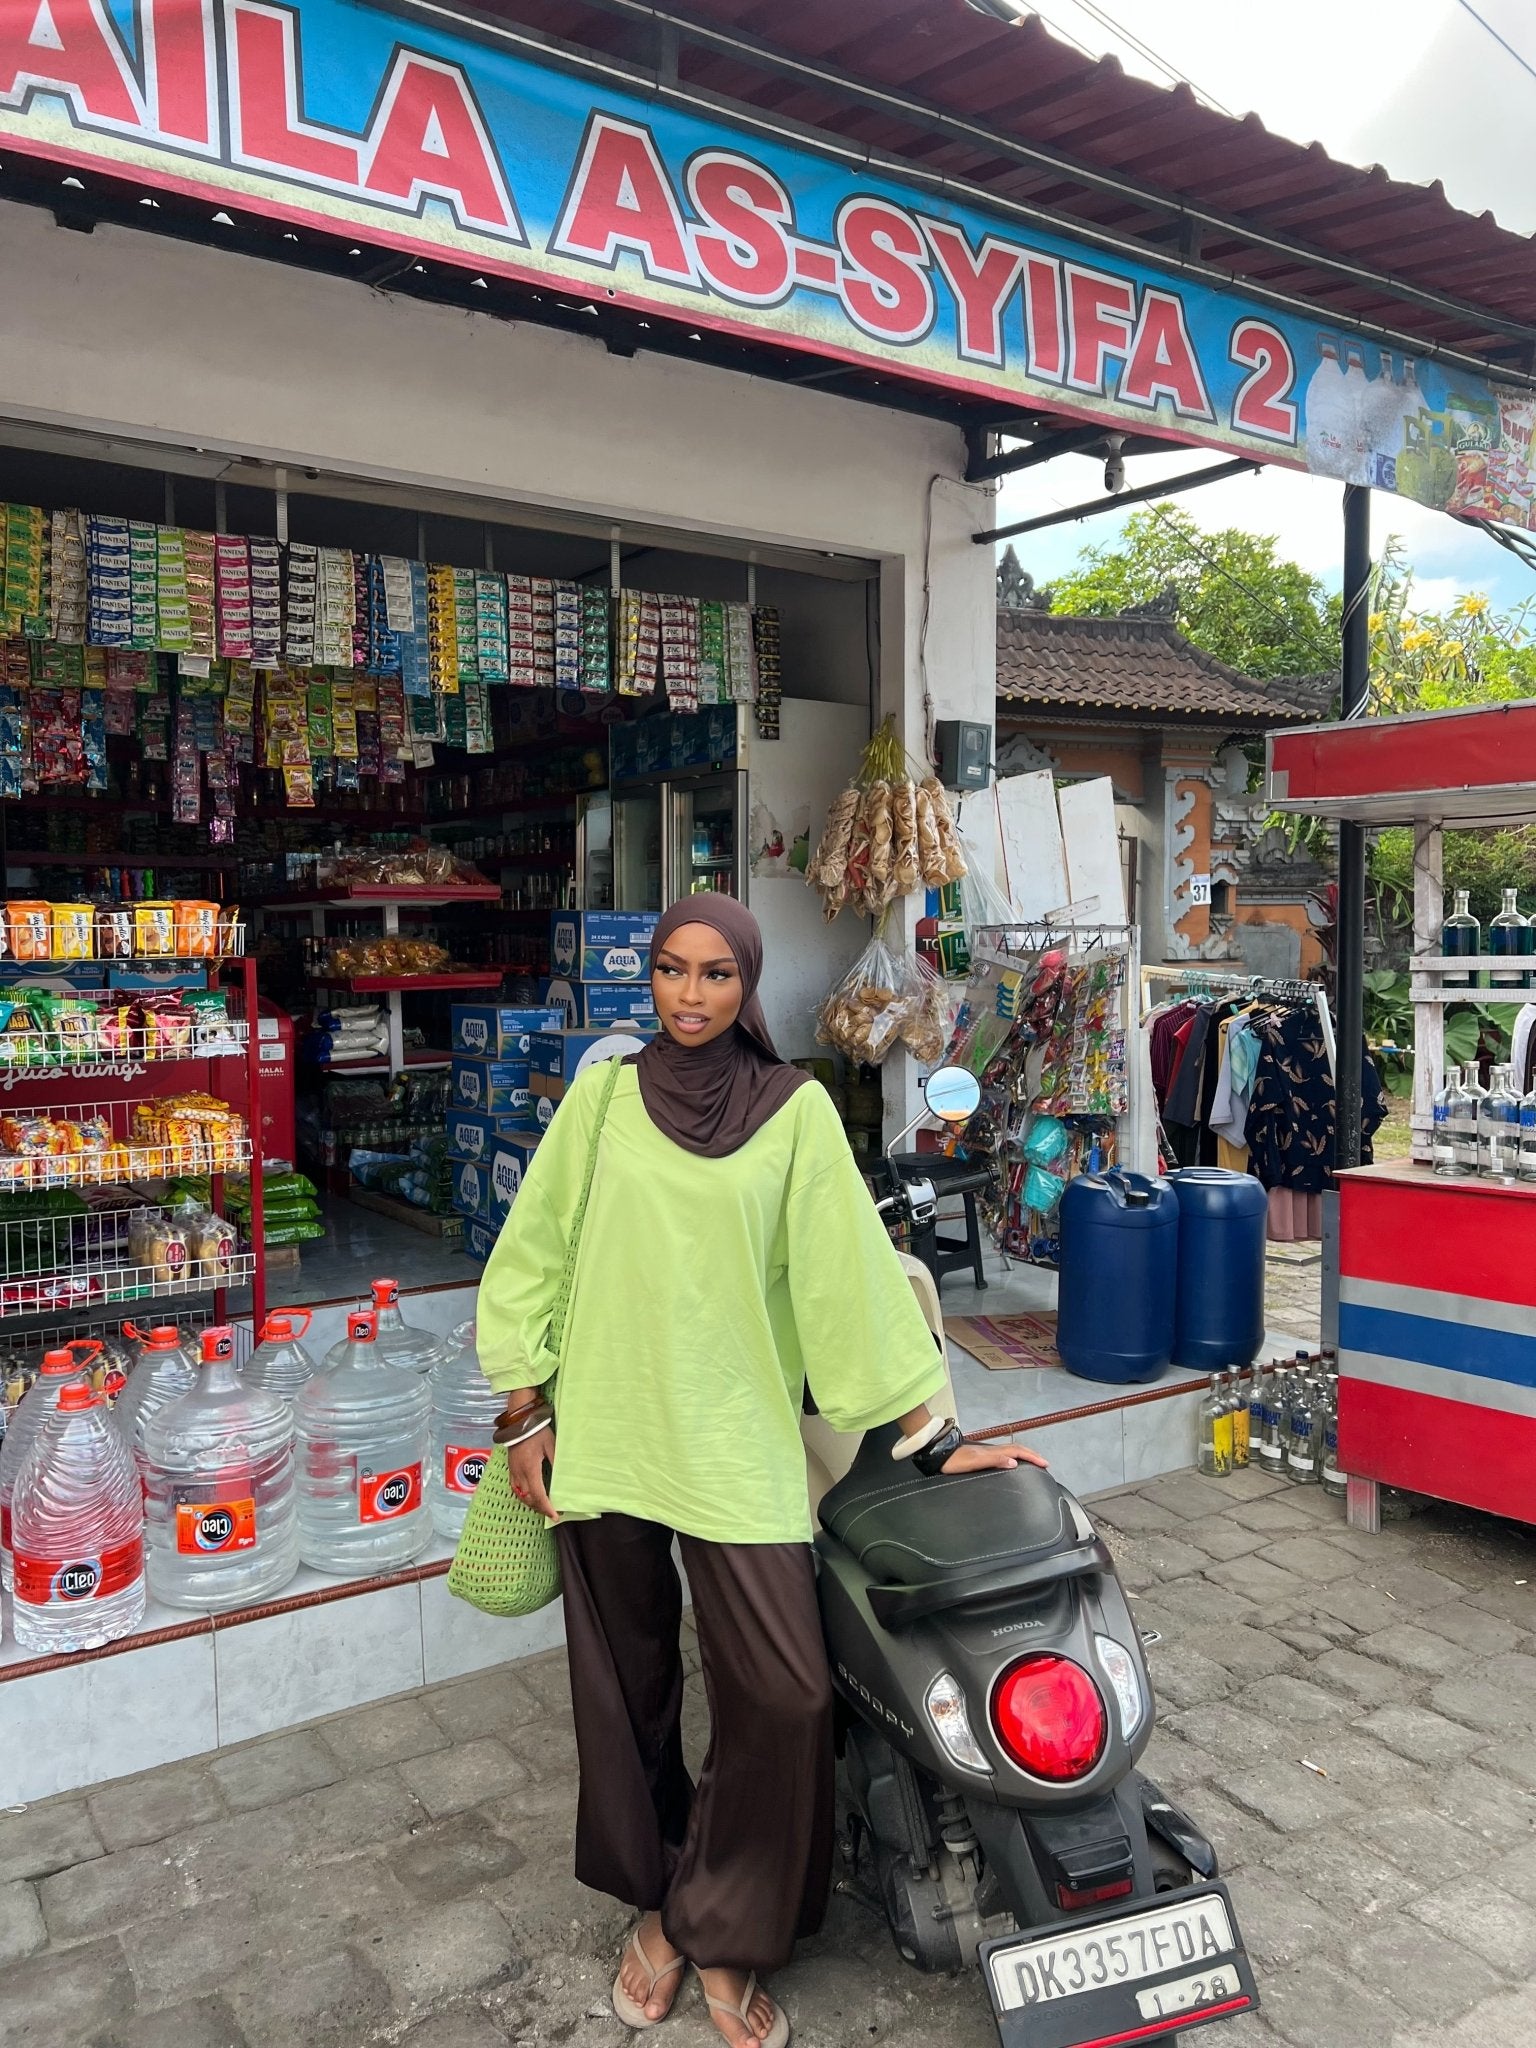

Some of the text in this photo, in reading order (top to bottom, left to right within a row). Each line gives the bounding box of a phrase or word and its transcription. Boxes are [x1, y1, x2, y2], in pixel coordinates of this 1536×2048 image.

[547, 107, 1216, 424] AS-SYIFA
[1230, 317, 1298, 447] 2
[1194, 885, 1207, 902] 37
[609, 956, 636, 967] AQUA
[465, 1022, 484, 1041] AQUA
[462, 1074, 477, 1094] AQUA
[515, 1092, 528, 1101] AQ
[459, 1127, 479, 1147] AQUA
[496, 1164, 518, 1194] AQUA
[462, 1179, 477, 1200] AQUA
[356, 1327, 369, 1336] Cleo
[384, 1484, 404, 1500] Cleo
[202, 1518, 228, 1535] Cleo
[65, 1572, 95, 1590] Cleo
[991, 1620, 1046, 1636] HONDA
